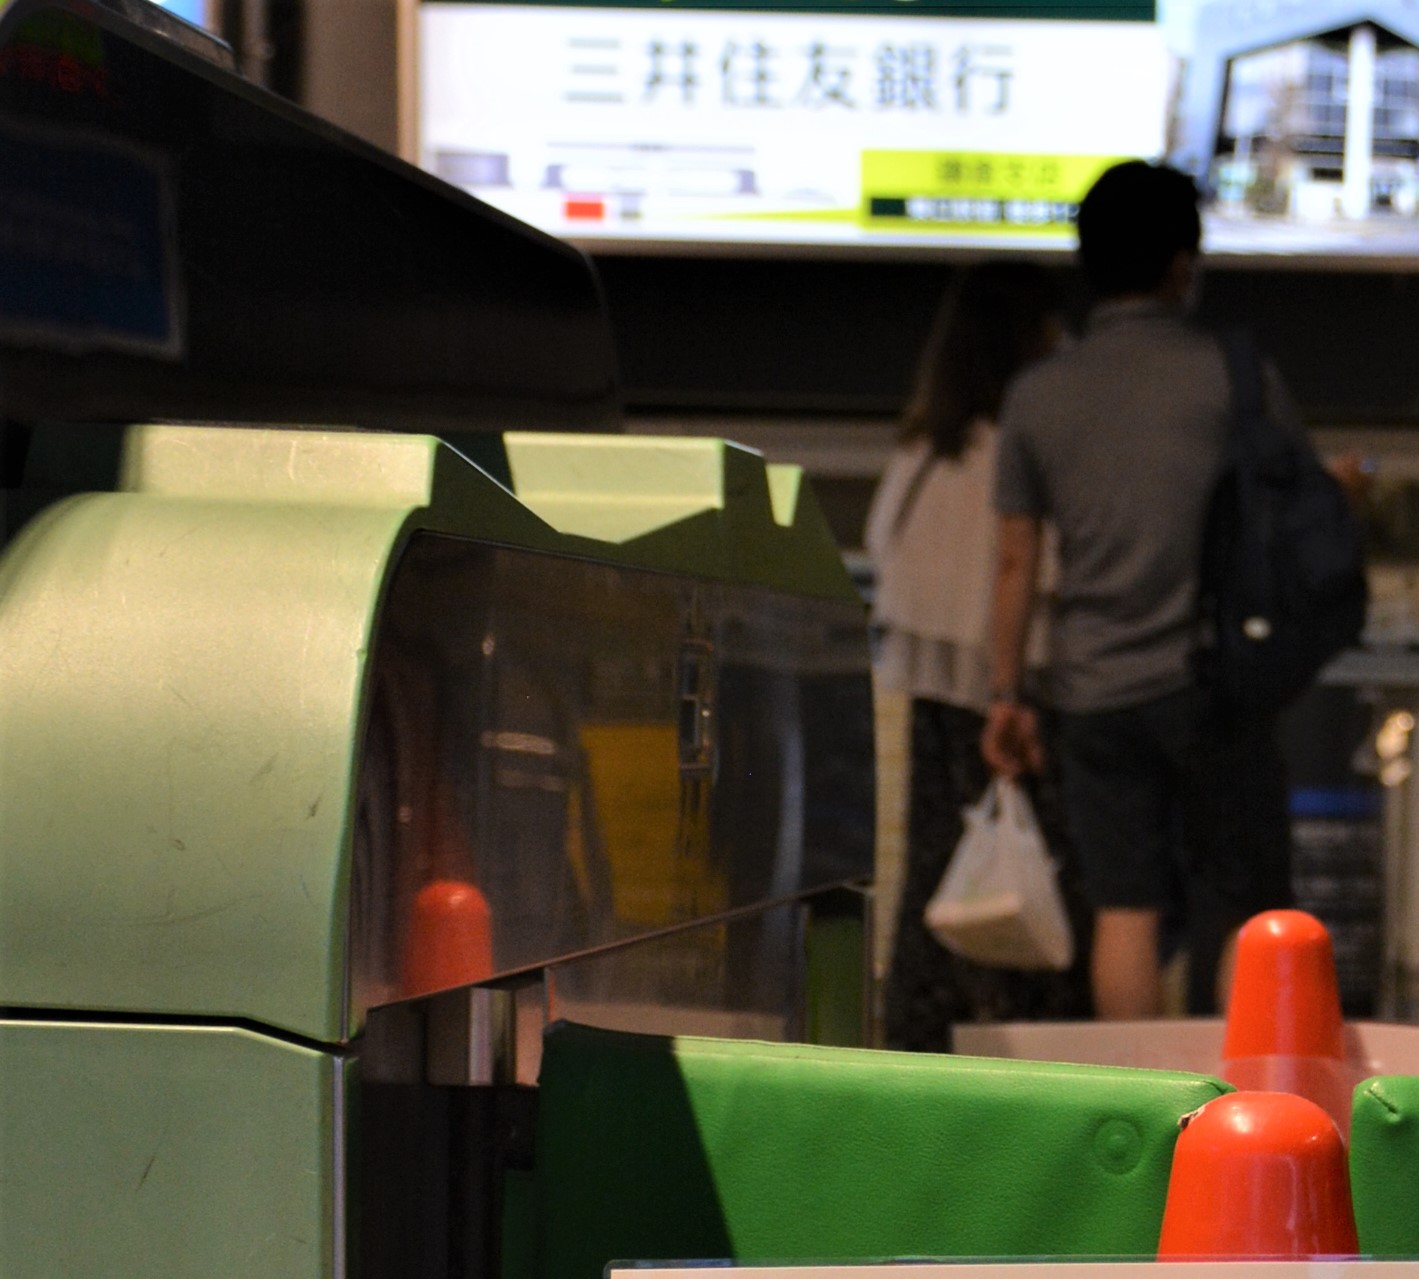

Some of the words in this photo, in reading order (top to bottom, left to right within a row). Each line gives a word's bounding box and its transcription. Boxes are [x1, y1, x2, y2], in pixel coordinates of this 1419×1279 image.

[564, 36, 1014, 116] 三井住友銀行
